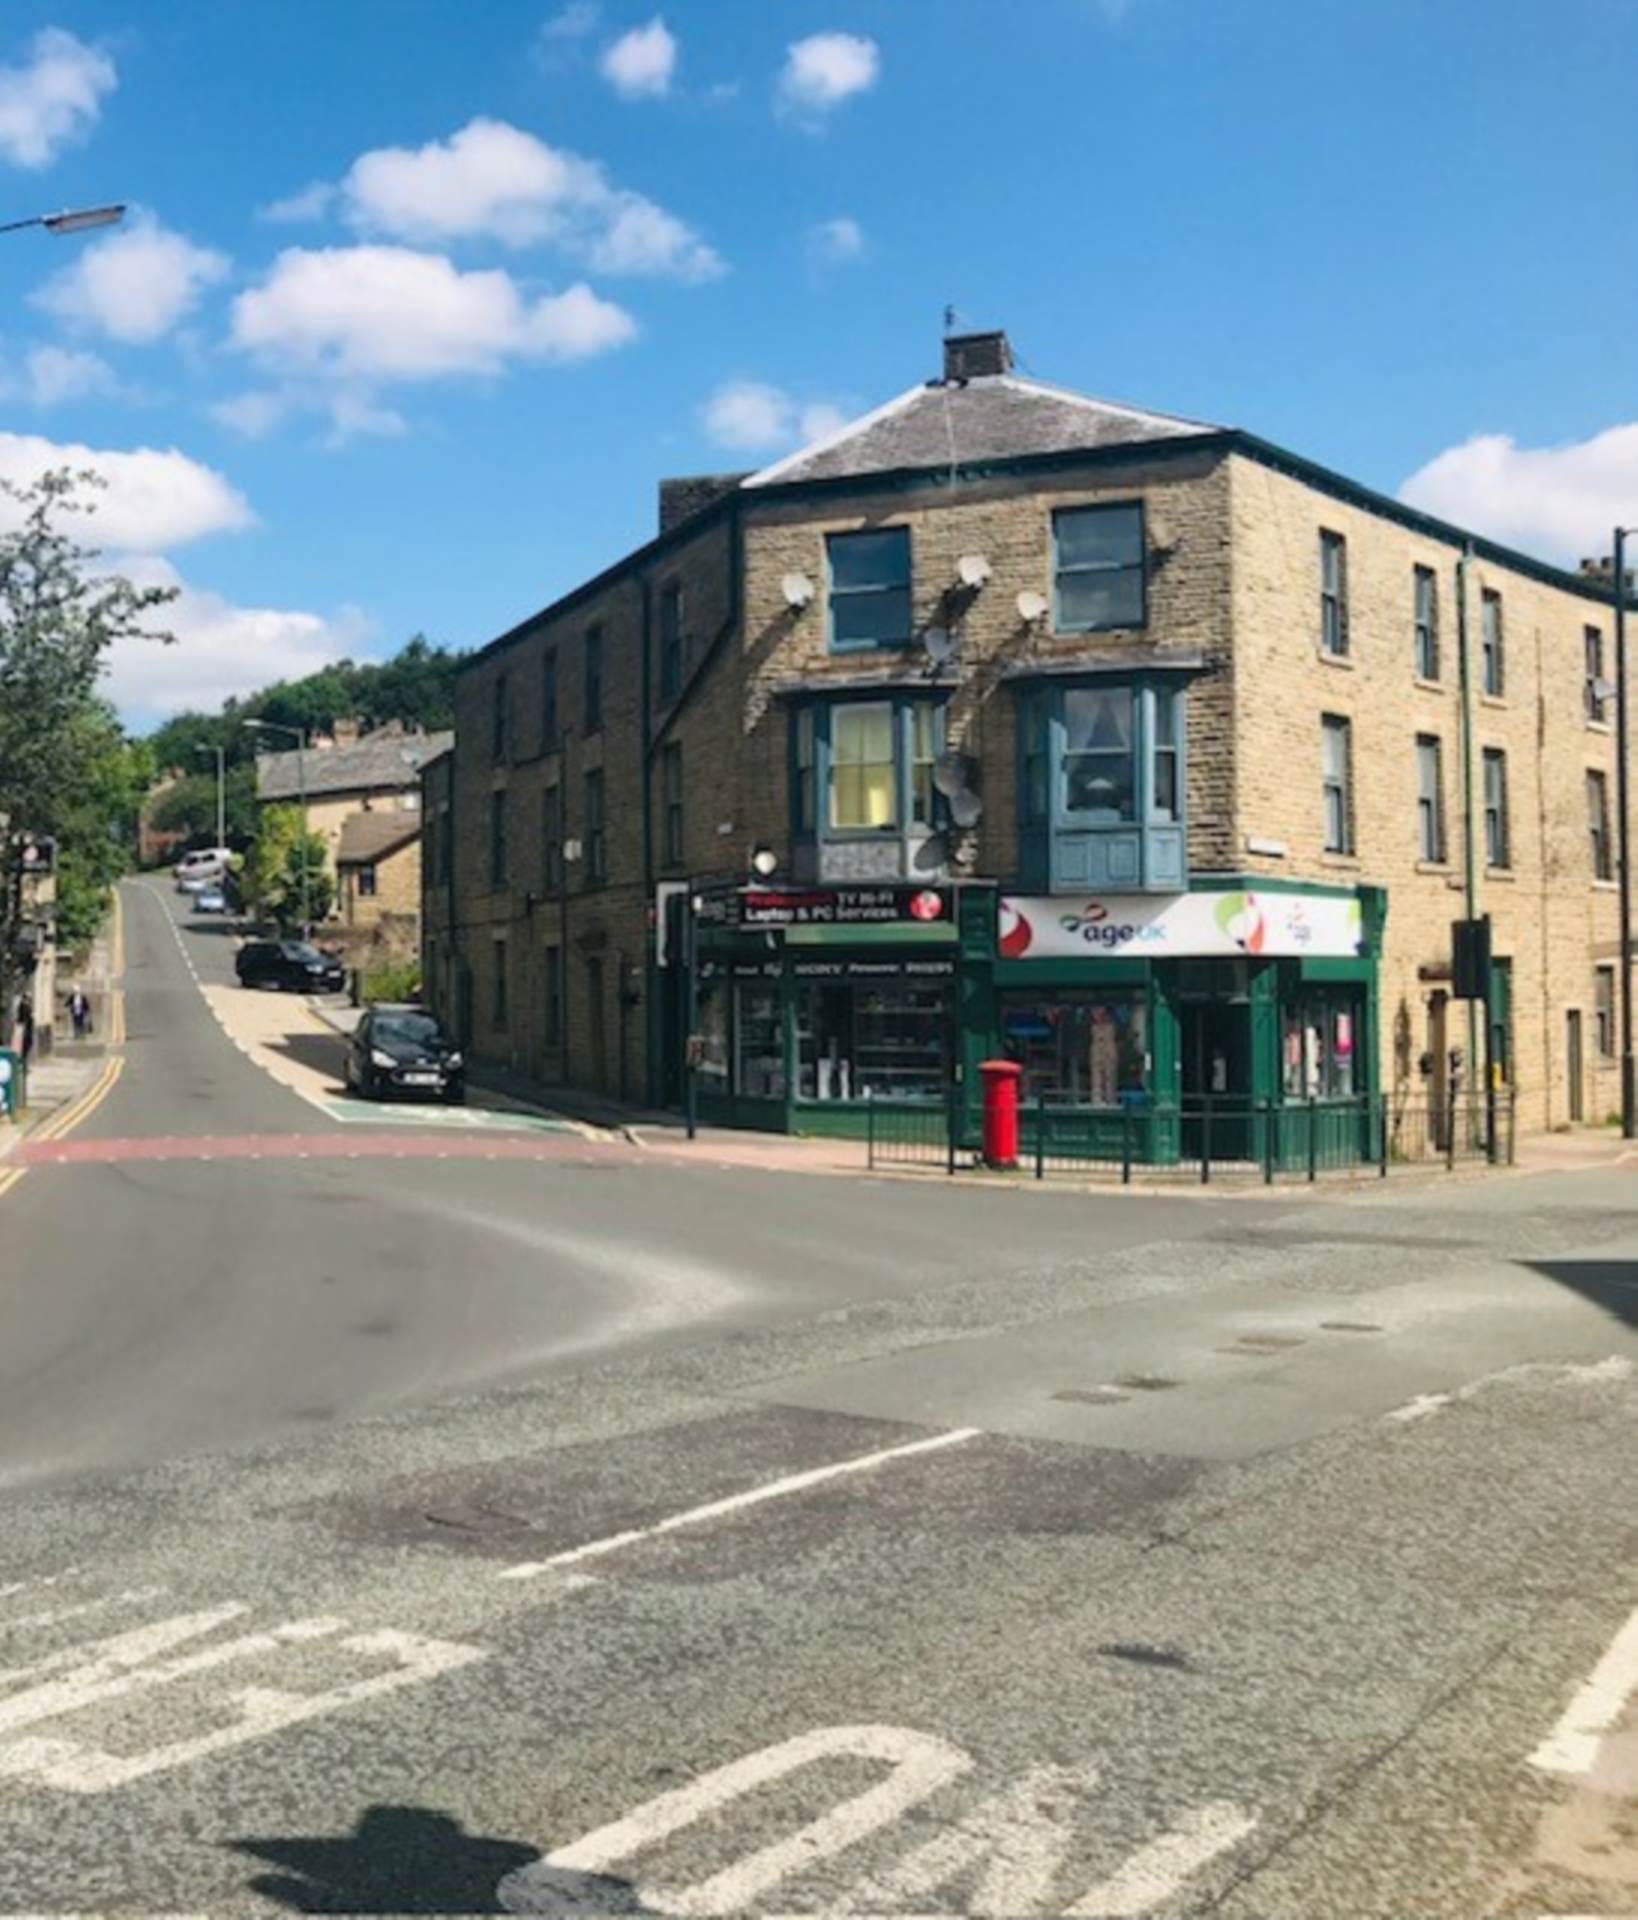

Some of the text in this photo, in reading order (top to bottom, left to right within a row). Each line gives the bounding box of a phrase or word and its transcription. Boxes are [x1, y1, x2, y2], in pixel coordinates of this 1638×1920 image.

[745, 907, 794, 921] Laptop
[812, 905, 833, 920] PC
[836, 906, 899, 921] Services
